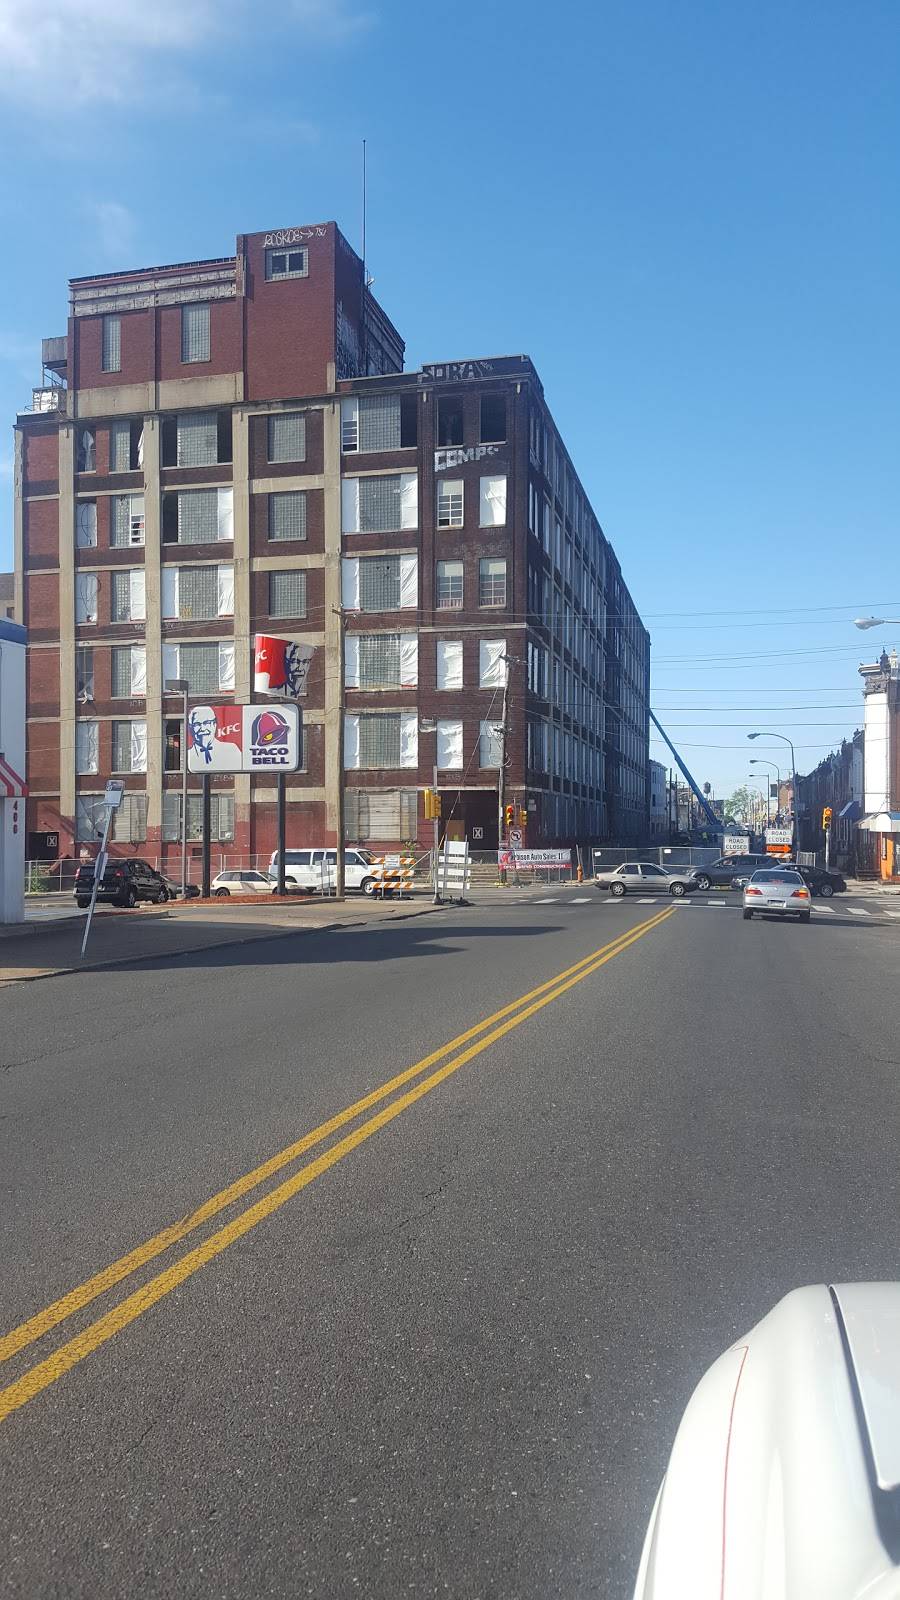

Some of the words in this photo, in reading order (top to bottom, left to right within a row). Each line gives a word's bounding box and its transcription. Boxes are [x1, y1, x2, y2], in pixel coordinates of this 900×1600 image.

[217, 722, 241, 738] KFC
[249, 747, 290, 756] TACO
[252, 757, 290, 765] BELL
